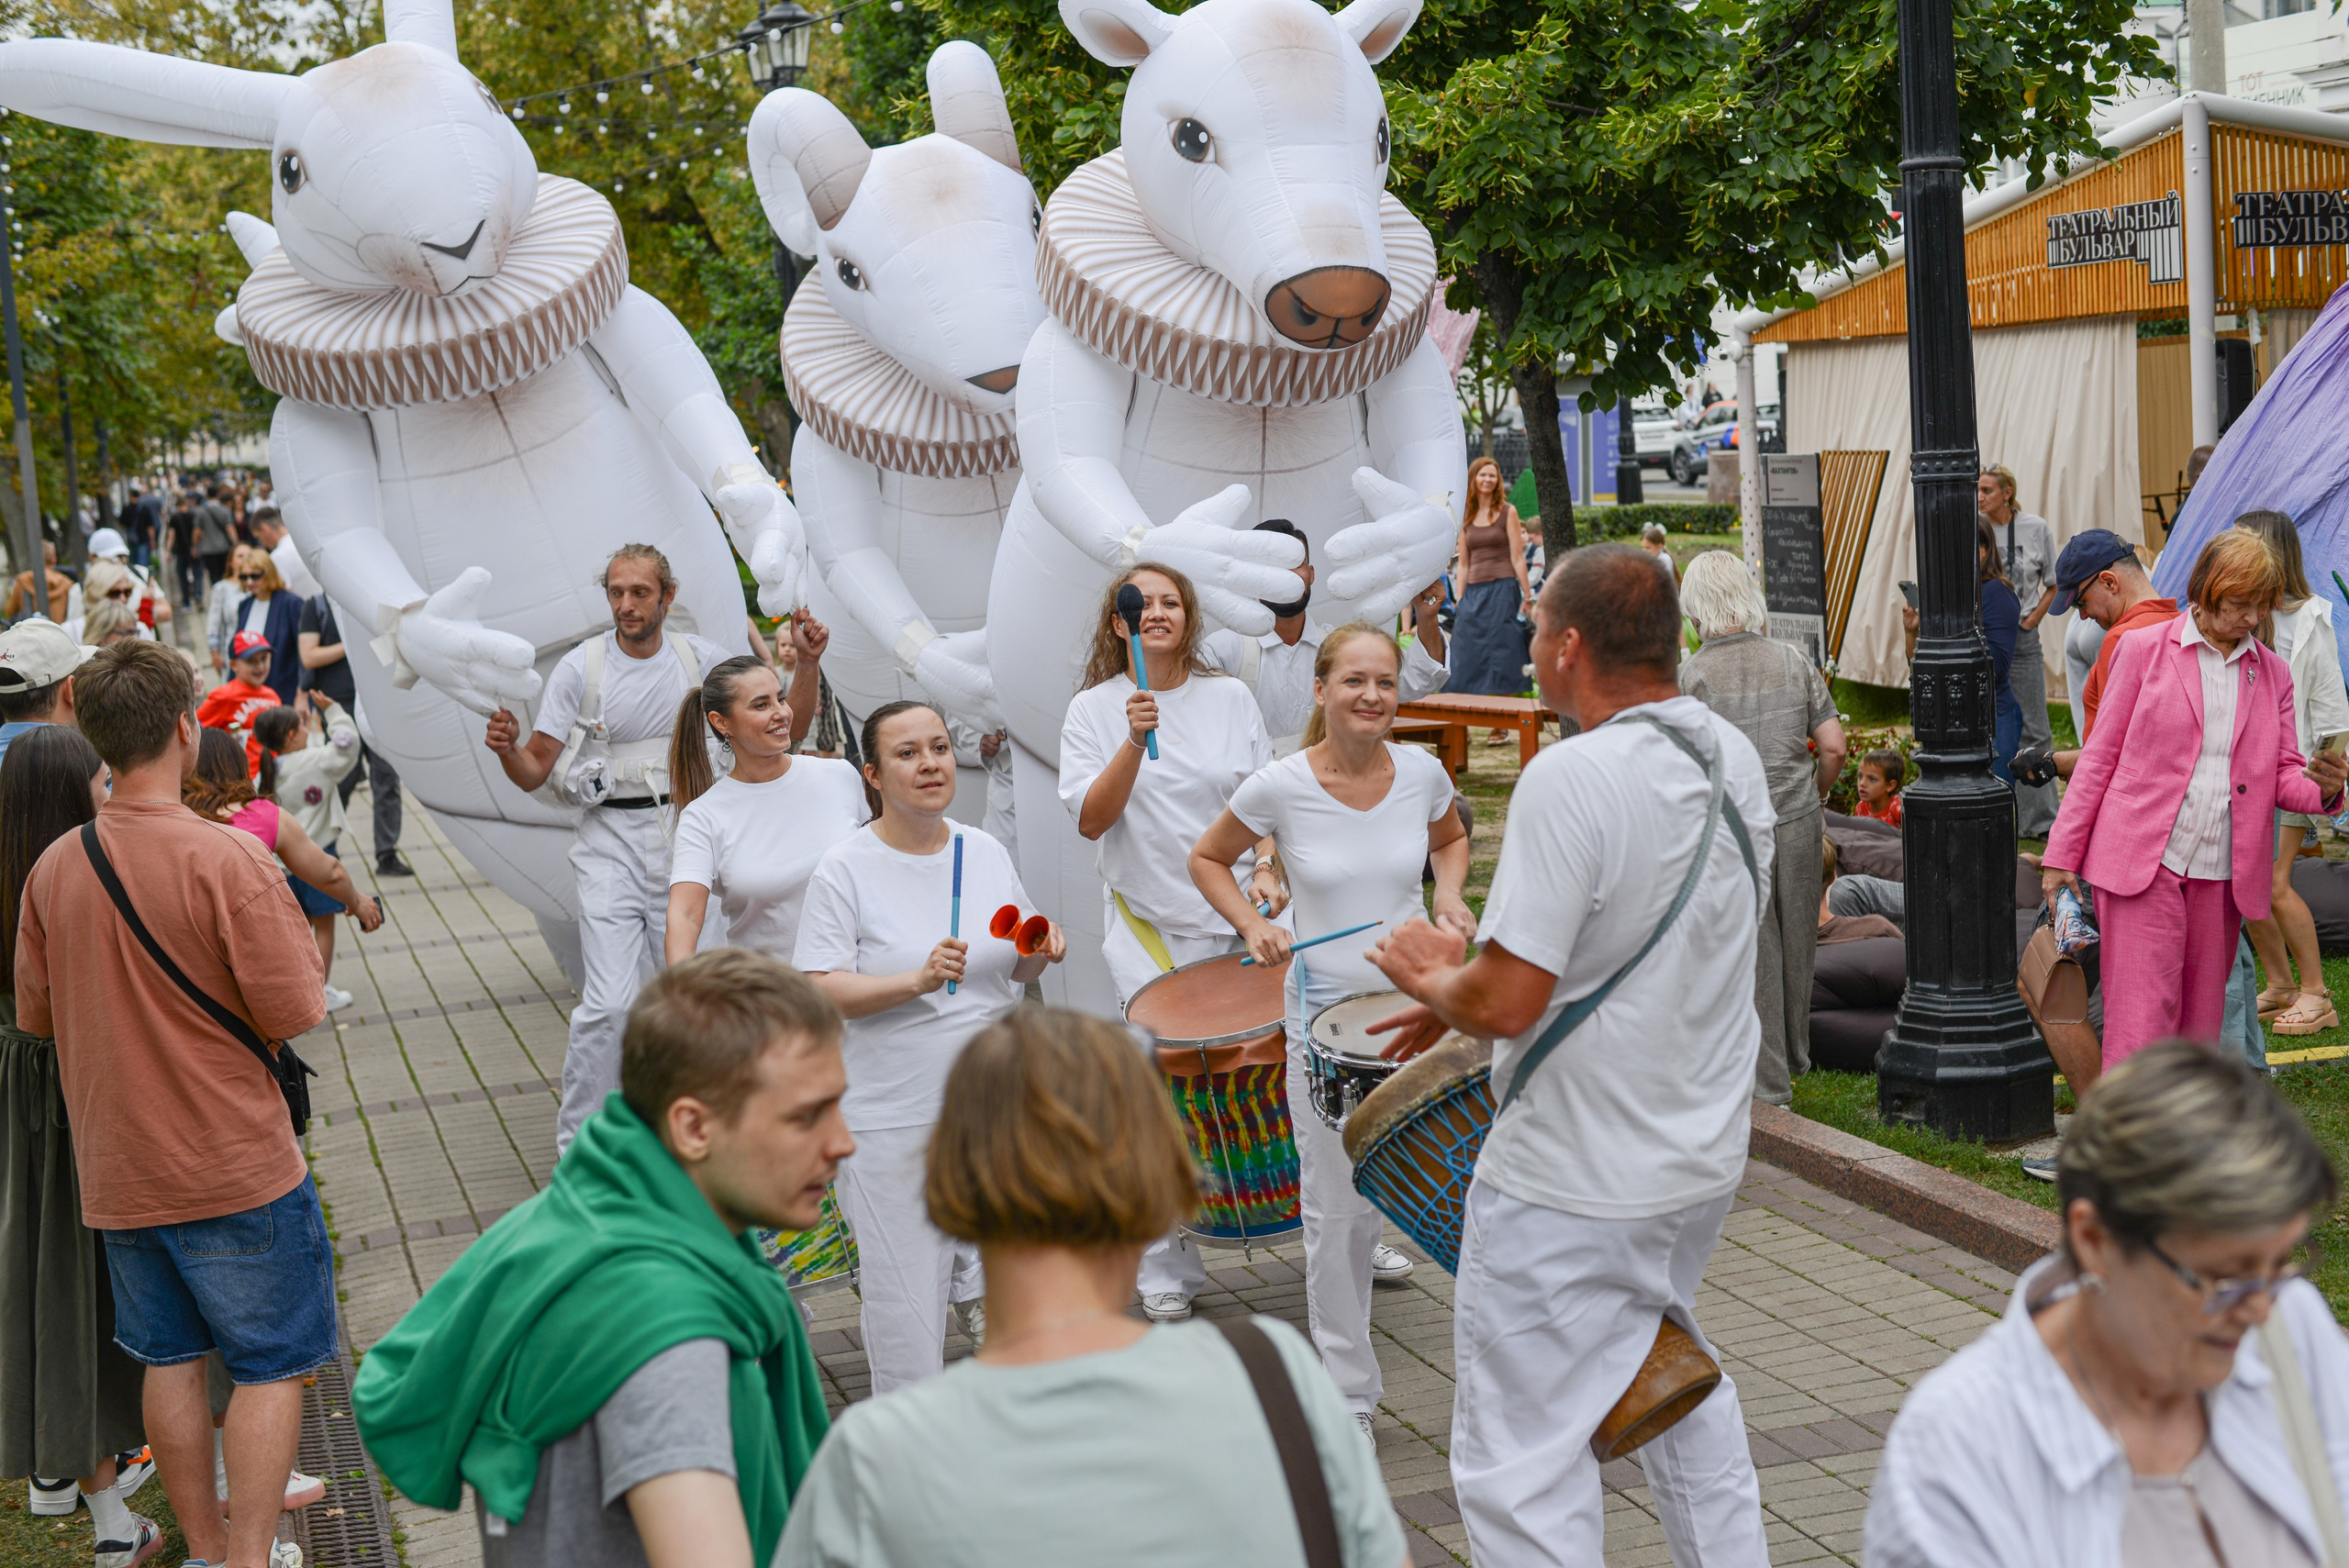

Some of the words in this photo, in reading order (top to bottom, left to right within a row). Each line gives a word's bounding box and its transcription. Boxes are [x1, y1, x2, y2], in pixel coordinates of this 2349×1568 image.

[2047, 191, 2179, 239] ТЕАТРАЛЬНЫЙ
[2236, 191, 2349, 217] ТЕАТРА
[2259, 215, 2349, 244] БУЛЬВ
[2059, 229, 2135, 263] БУЛЬВАР
[1771, 617, 1819, 632] ТЕАТРАЛЬНЫЙ
